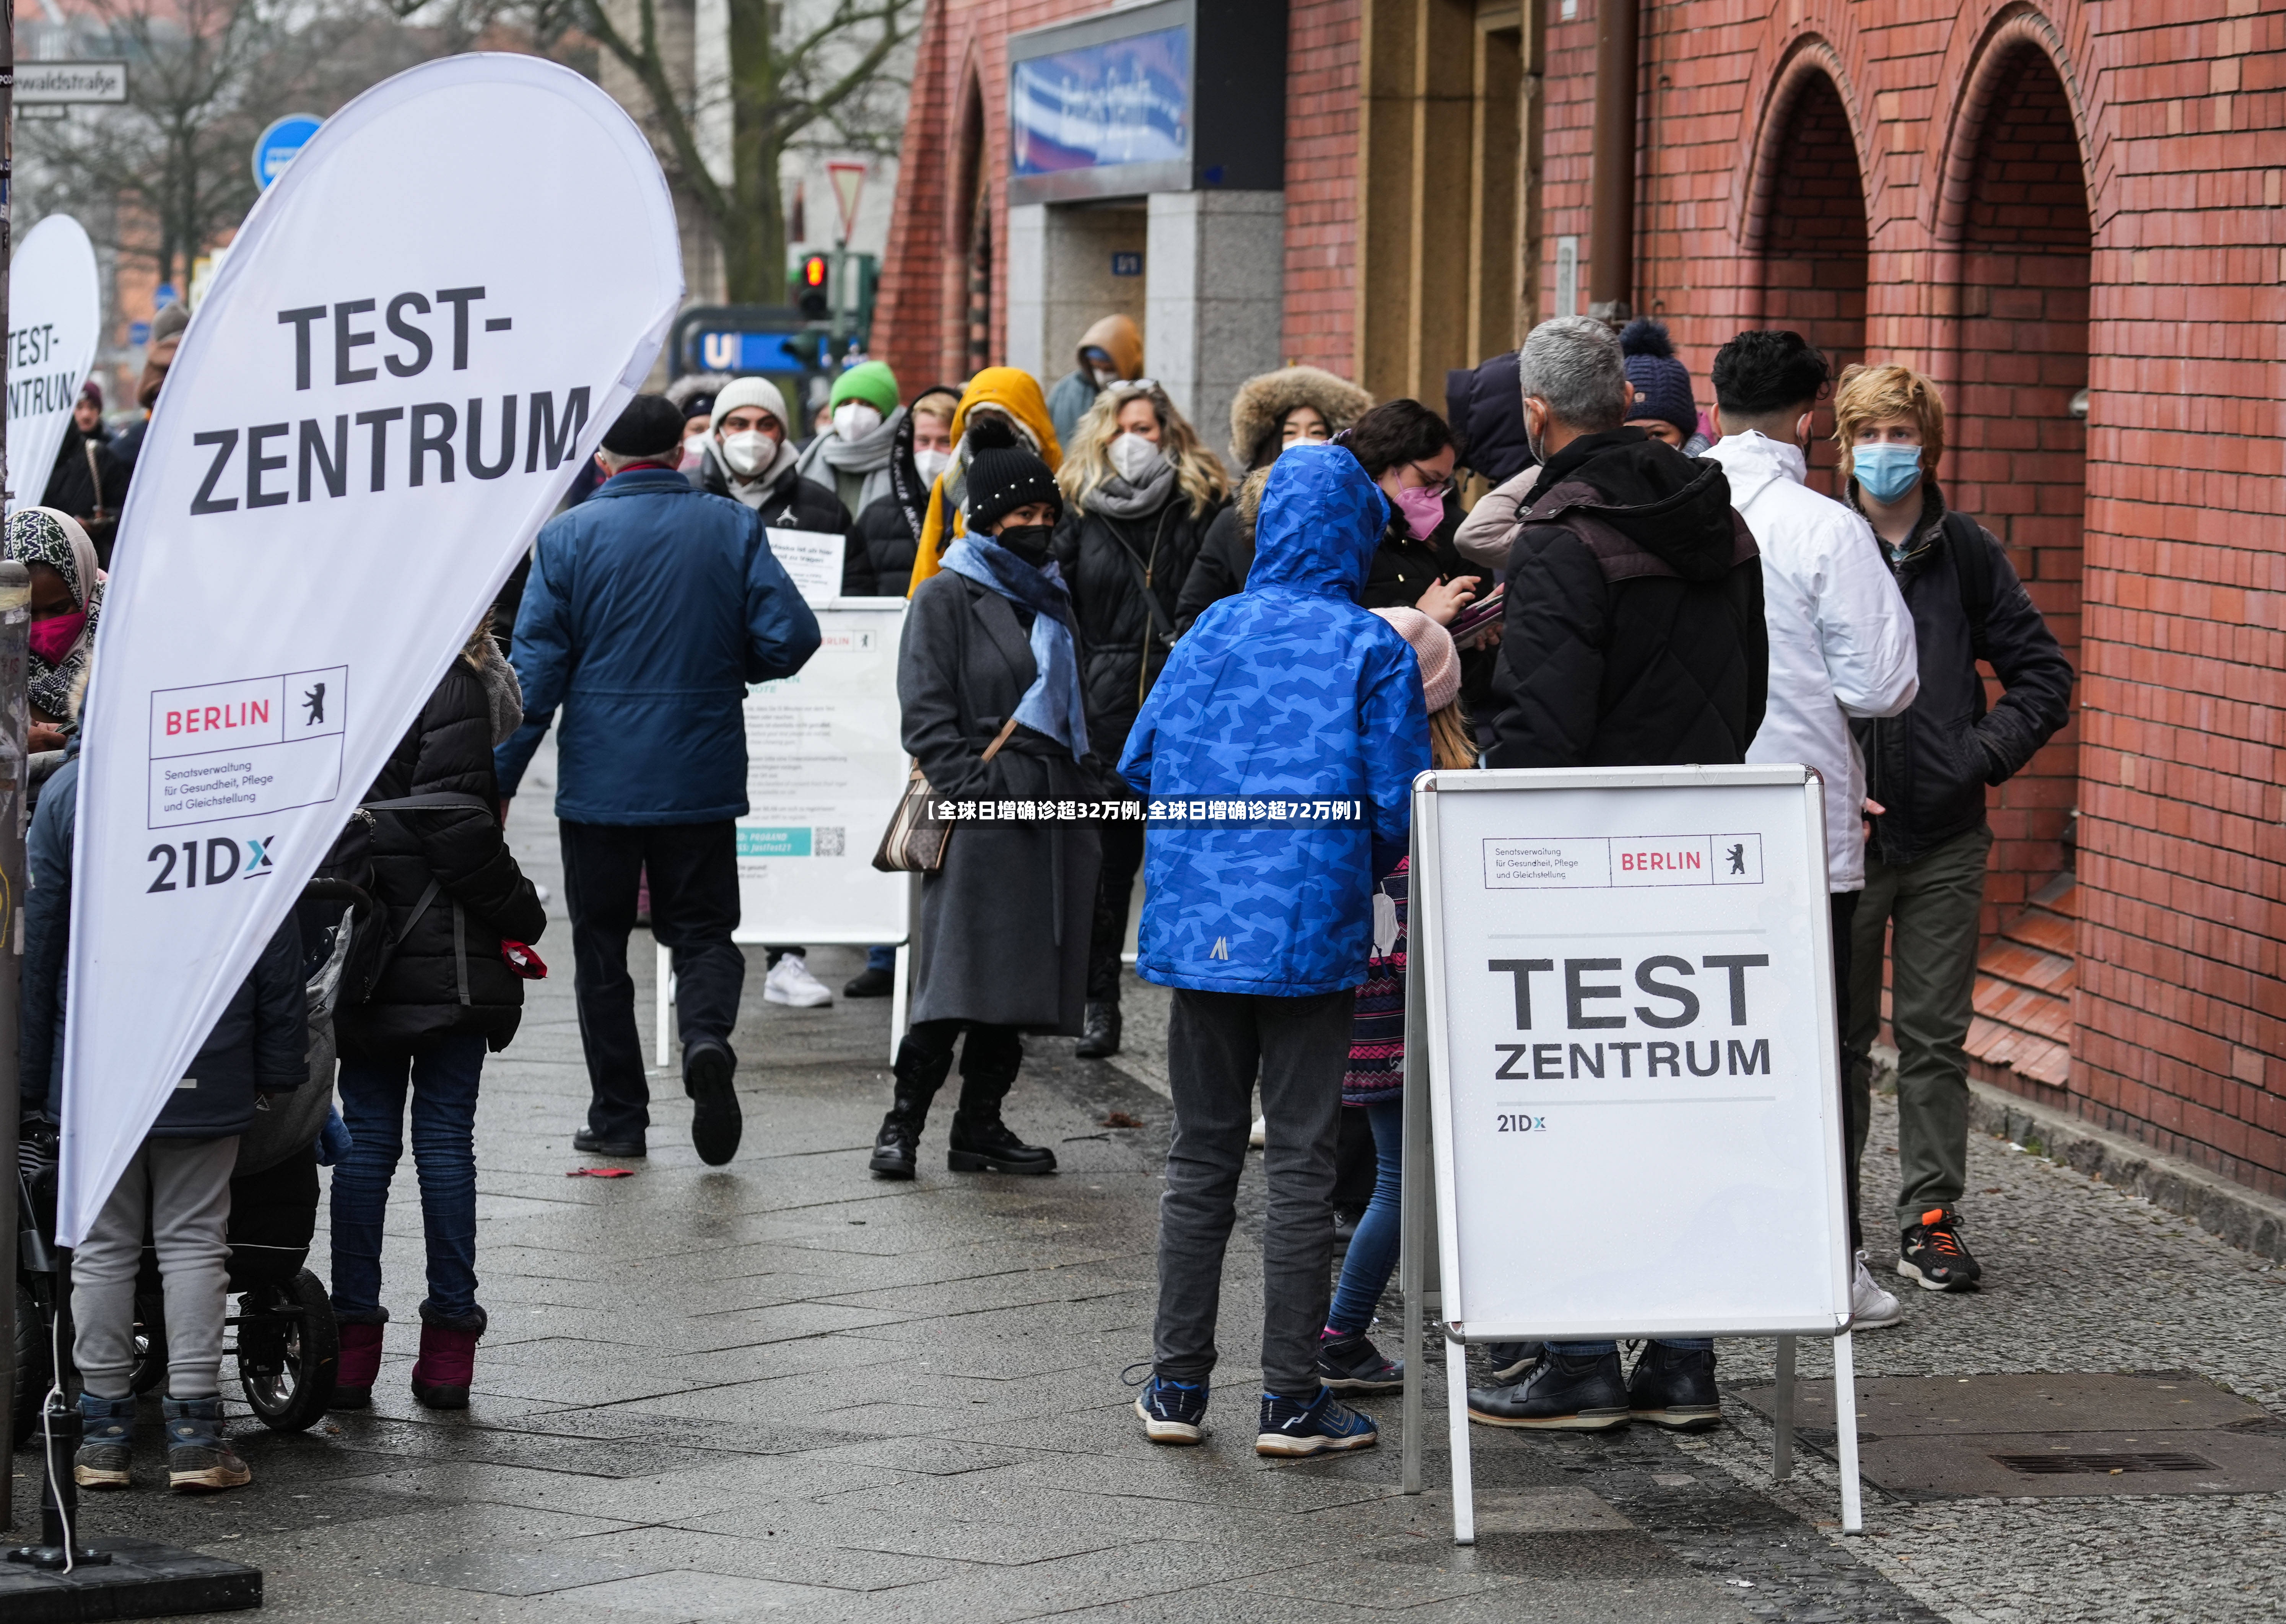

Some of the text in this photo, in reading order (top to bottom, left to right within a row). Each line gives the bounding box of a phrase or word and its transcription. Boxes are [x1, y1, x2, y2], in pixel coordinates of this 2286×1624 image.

[8, 324, 59, 369] TEST-
[278, 286, 511, 391] TEST-
[705, 333, 732, 369] U
[190, 386, 591, 516] ZENTRUM
[167, 700, 268, 736] BERLIN
[164, 775, 273, 796] für Gesundheit, Pflege
[165, 763, 251, 780] Senatsverwaltung
[164, 793, 255, 812] und Gleichstellung
[1495, 848, 1700, 871] Senatsverwaltung BERLIN
[1508, 859, 1552, 867] Gesundheit,
[1555, 859, 1578, 868] Pflege
[1513, 871, 1566, 879] Gleichstellung
[1488, 954, 1769, 1030] TEST
[1495, 1039, 1770, 1080] ZENTRUM
